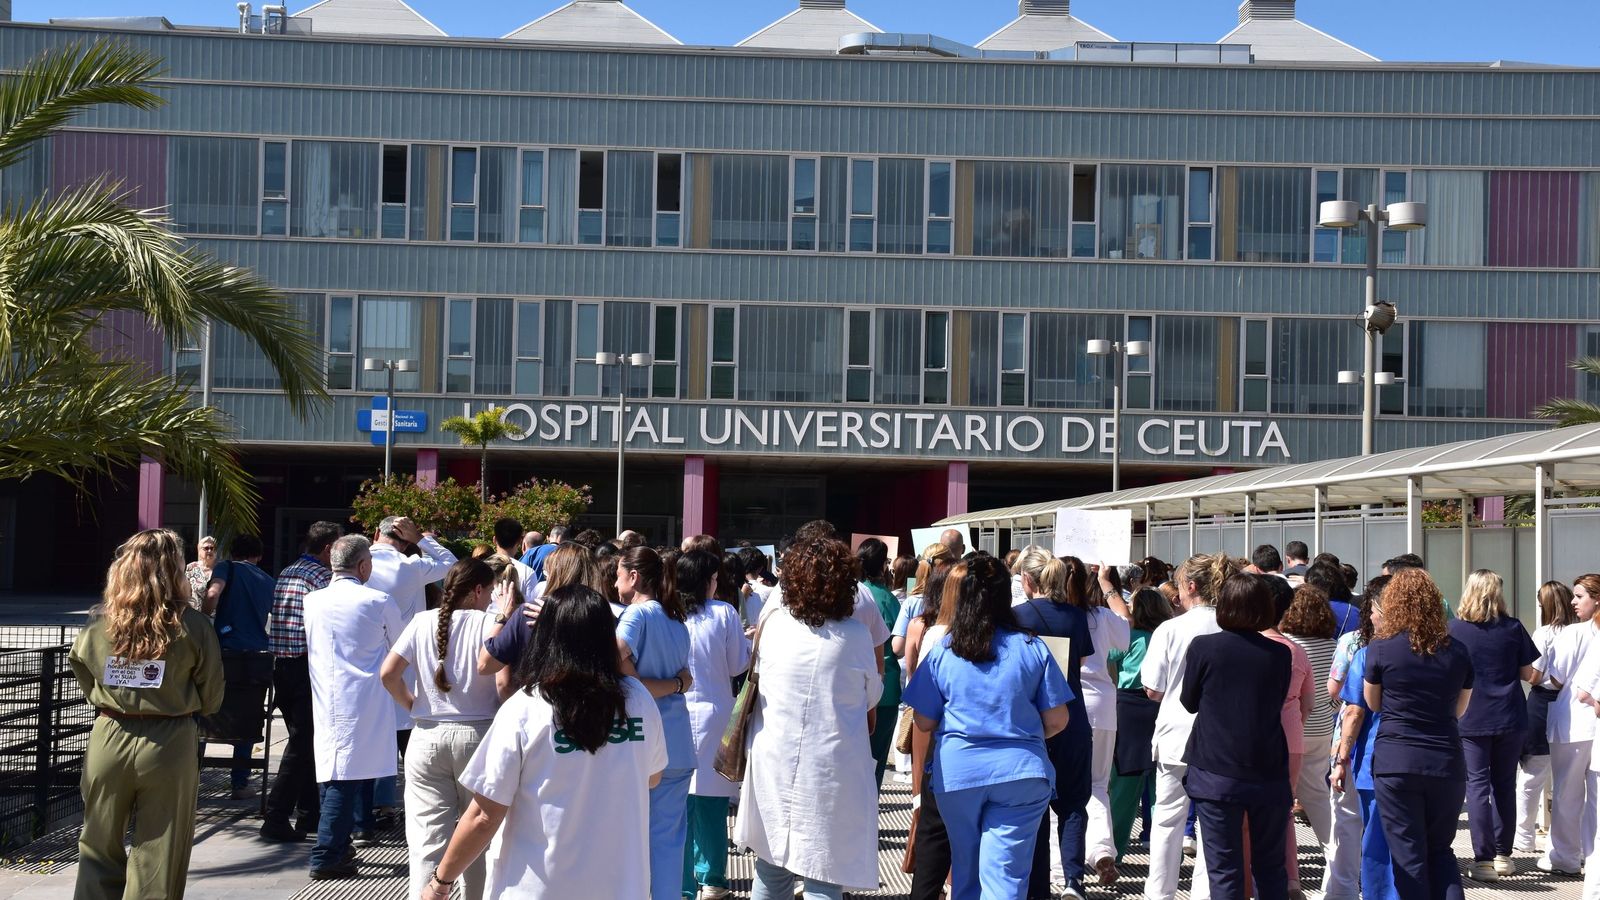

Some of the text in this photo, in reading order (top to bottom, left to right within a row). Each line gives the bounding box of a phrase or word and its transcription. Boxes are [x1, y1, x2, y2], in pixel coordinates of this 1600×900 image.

[700, 407, 1045, 452] UNIVERSITARIO
[1061, 416, 1121, 454] DE
[1137, 418, 1291, 458] CEUTA
[553, 717, 645, 754] SSE
